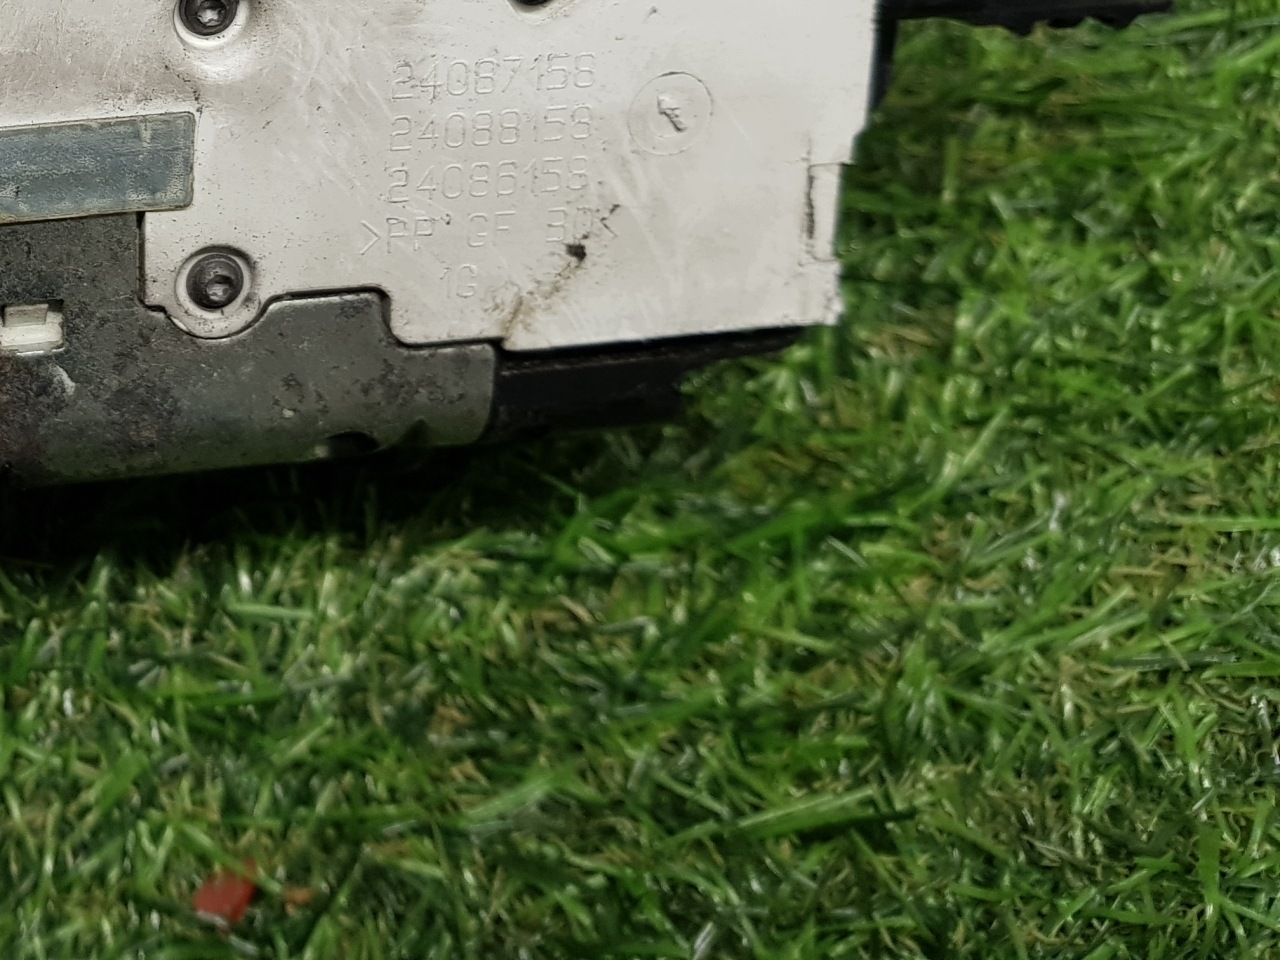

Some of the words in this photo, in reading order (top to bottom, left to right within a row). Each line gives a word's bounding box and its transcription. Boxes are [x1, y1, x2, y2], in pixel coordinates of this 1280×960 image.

[391, 51, 596, 101] 24087158
[389, 103, 592, 152] 24088158
[387, 155, 589, 204] 24086158
